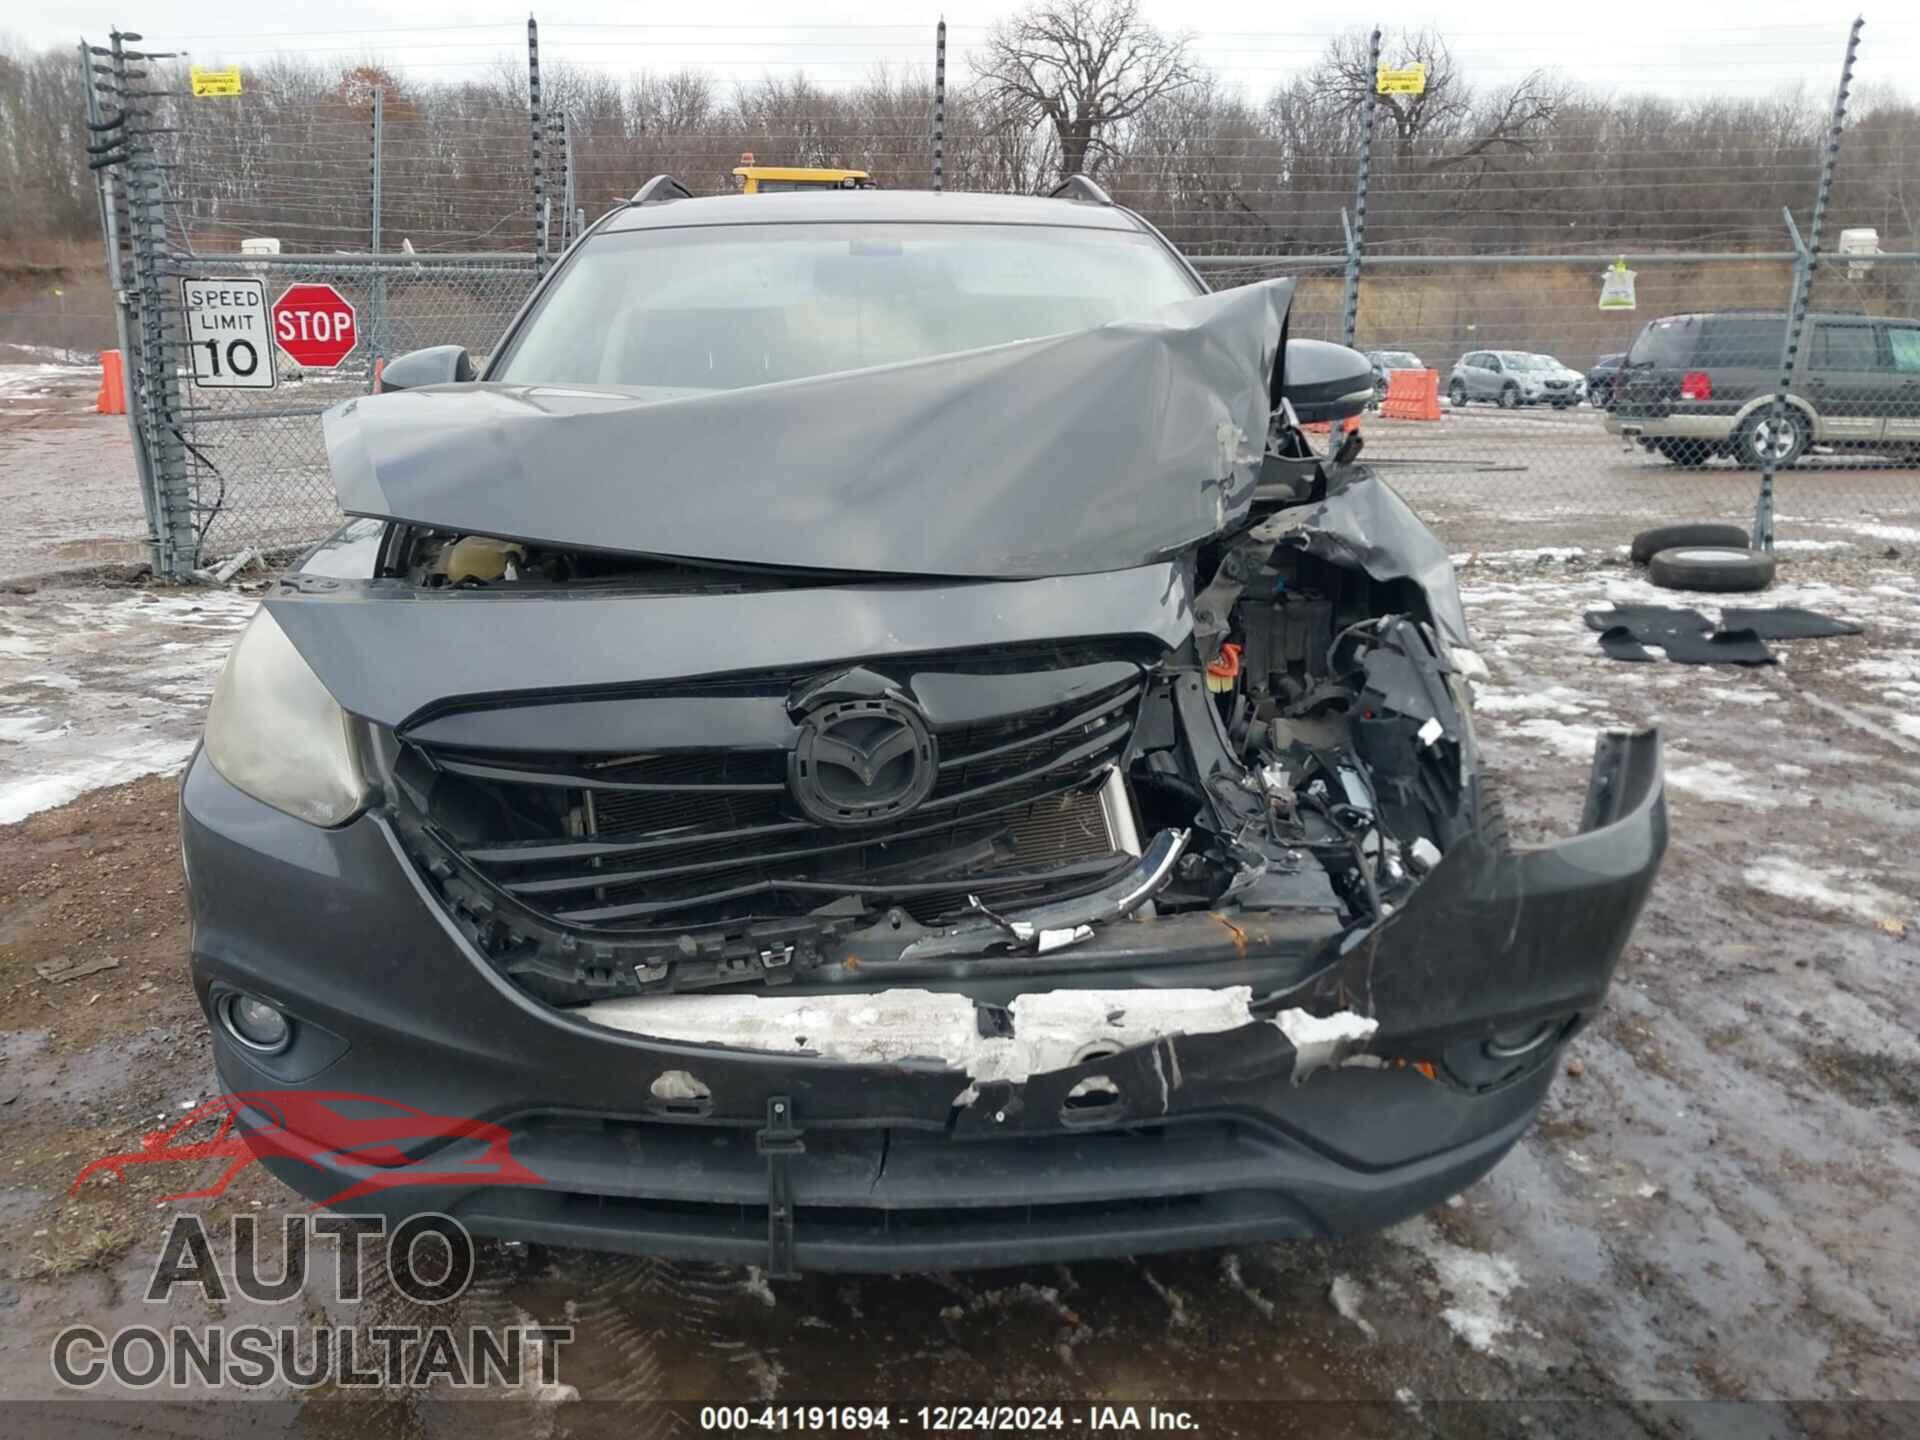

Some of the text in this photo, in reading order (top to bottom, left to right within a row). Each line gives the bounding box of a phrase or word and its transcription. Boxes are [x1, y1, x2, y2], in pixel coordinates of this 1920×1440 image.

[192, 290, 259, 306] SPEED
[201, 314, 254, 330] LIMIT
[278, 310, 351, 342] STOP
[205, 338, 258, 377] 10
